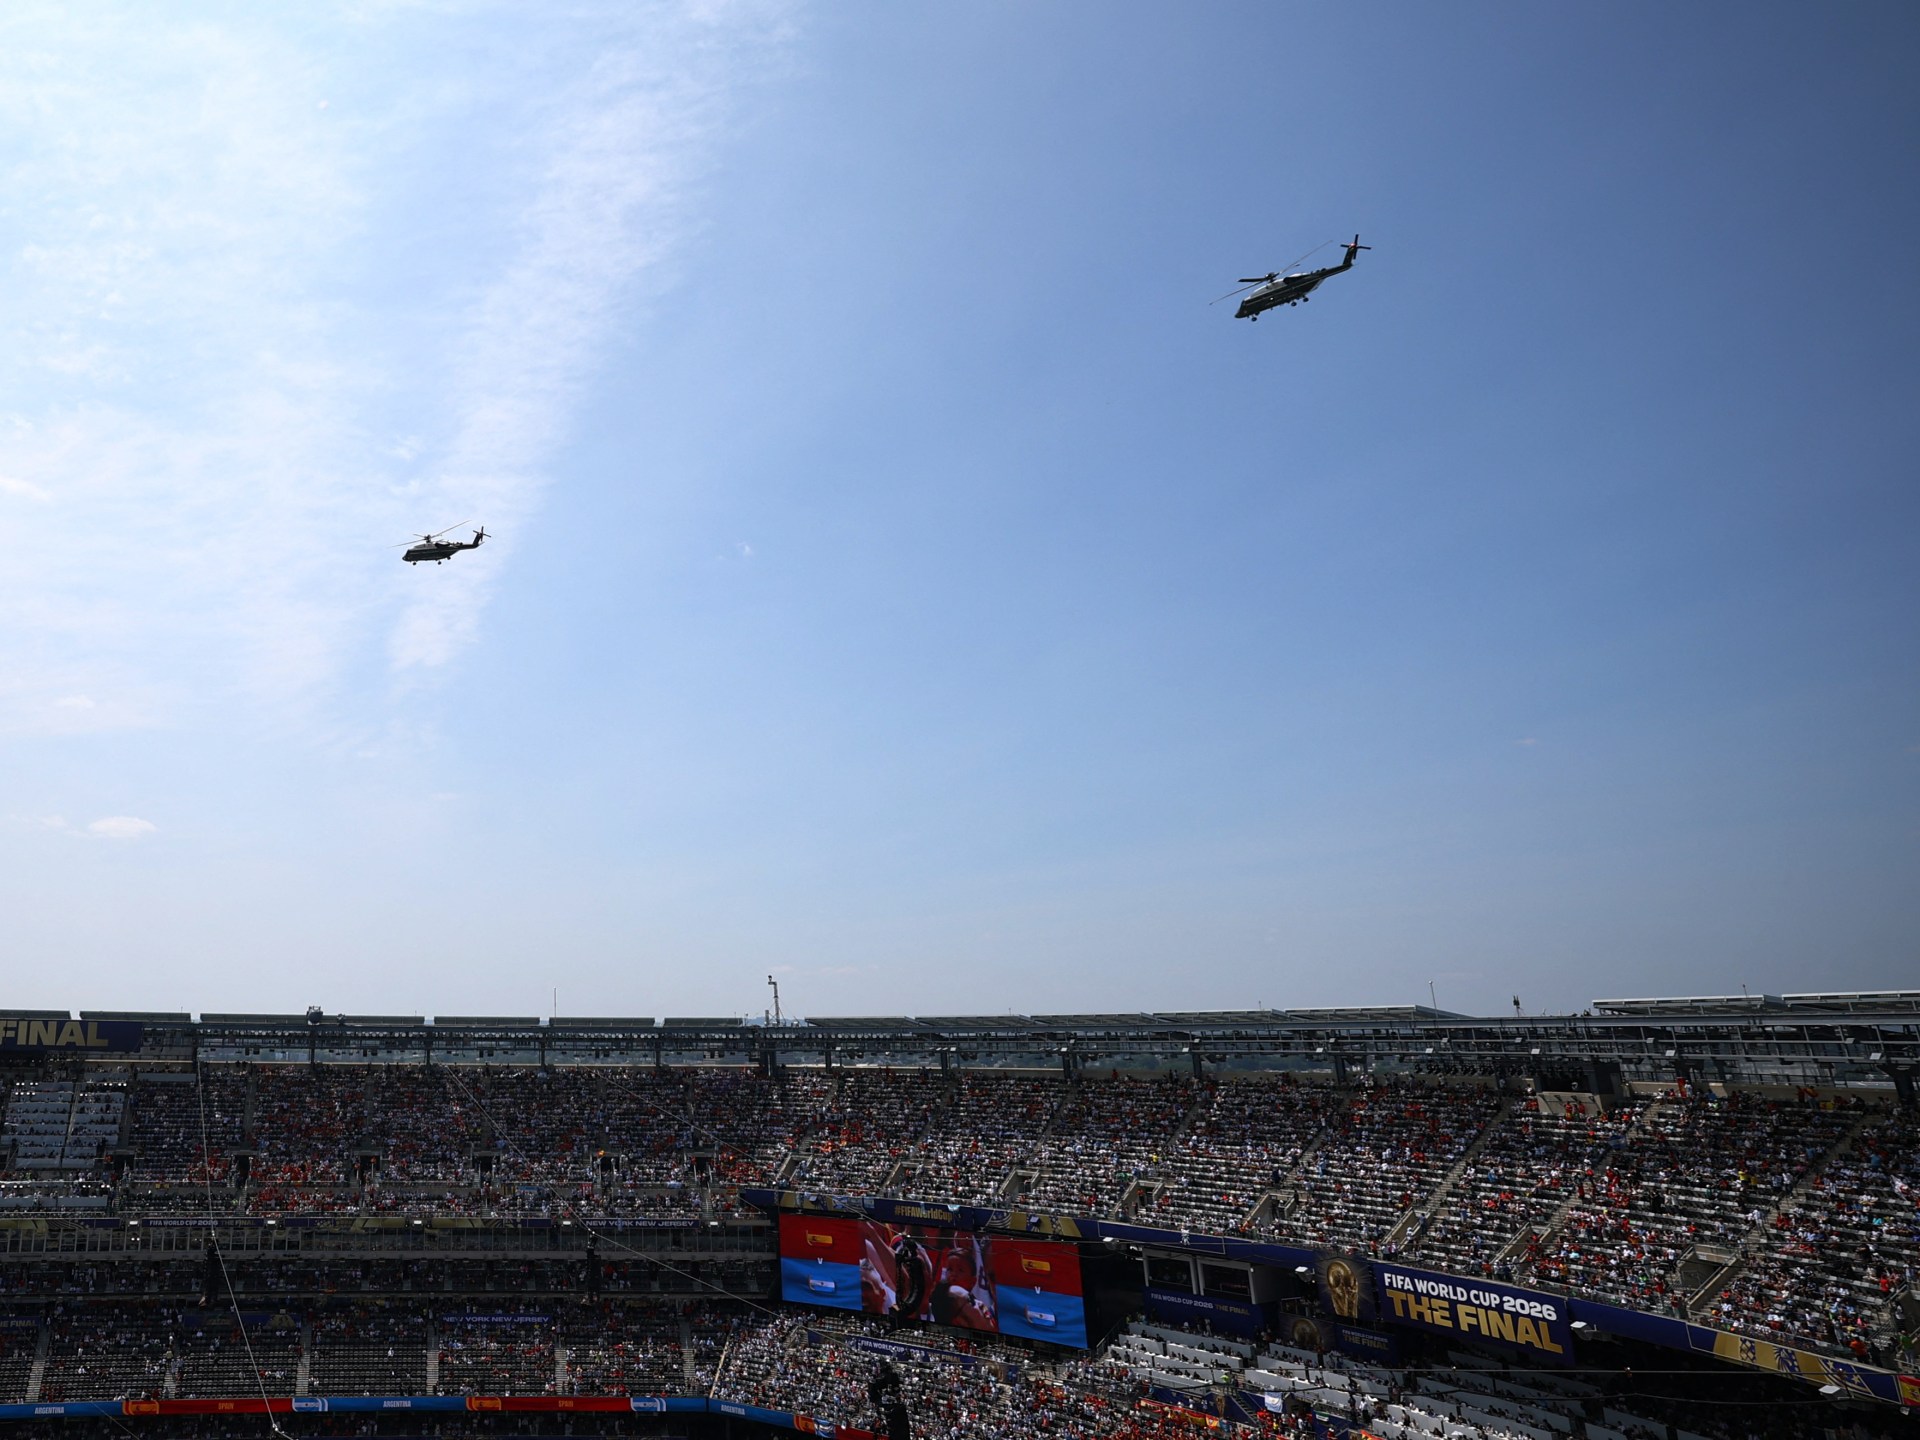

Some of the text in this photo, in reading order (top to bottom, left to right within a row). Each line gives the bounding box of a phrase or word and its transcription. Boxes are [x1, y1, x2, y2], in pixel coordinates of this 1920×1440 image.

[0, 1020, 108, 1047] FINAL
[895, 1205, 953, 1223] #FIFAWorldCup
[1384, 1273, 1557, 1321] FIFA WORLD CUP 2026
[1162, 1295, 1181, 1303] WORLD
[1193, 1300, 1214, 1309] 2026
[1215, 1304, 1229, 1312] THE
[1229, 1306, 1250, 1316] FINAL
[1386, 1288, 1564, 1355] THE FINAL
[35, 1406, 65, 1414] ARGENTINA
[218, 1402, 235, 1411] SPAIN
[383, 1400, 411, 1408] ARGENTINA
[558, 1400, 574, 1408] SPAIN
[720, 1404, 746, 1416] ARGENTINA
